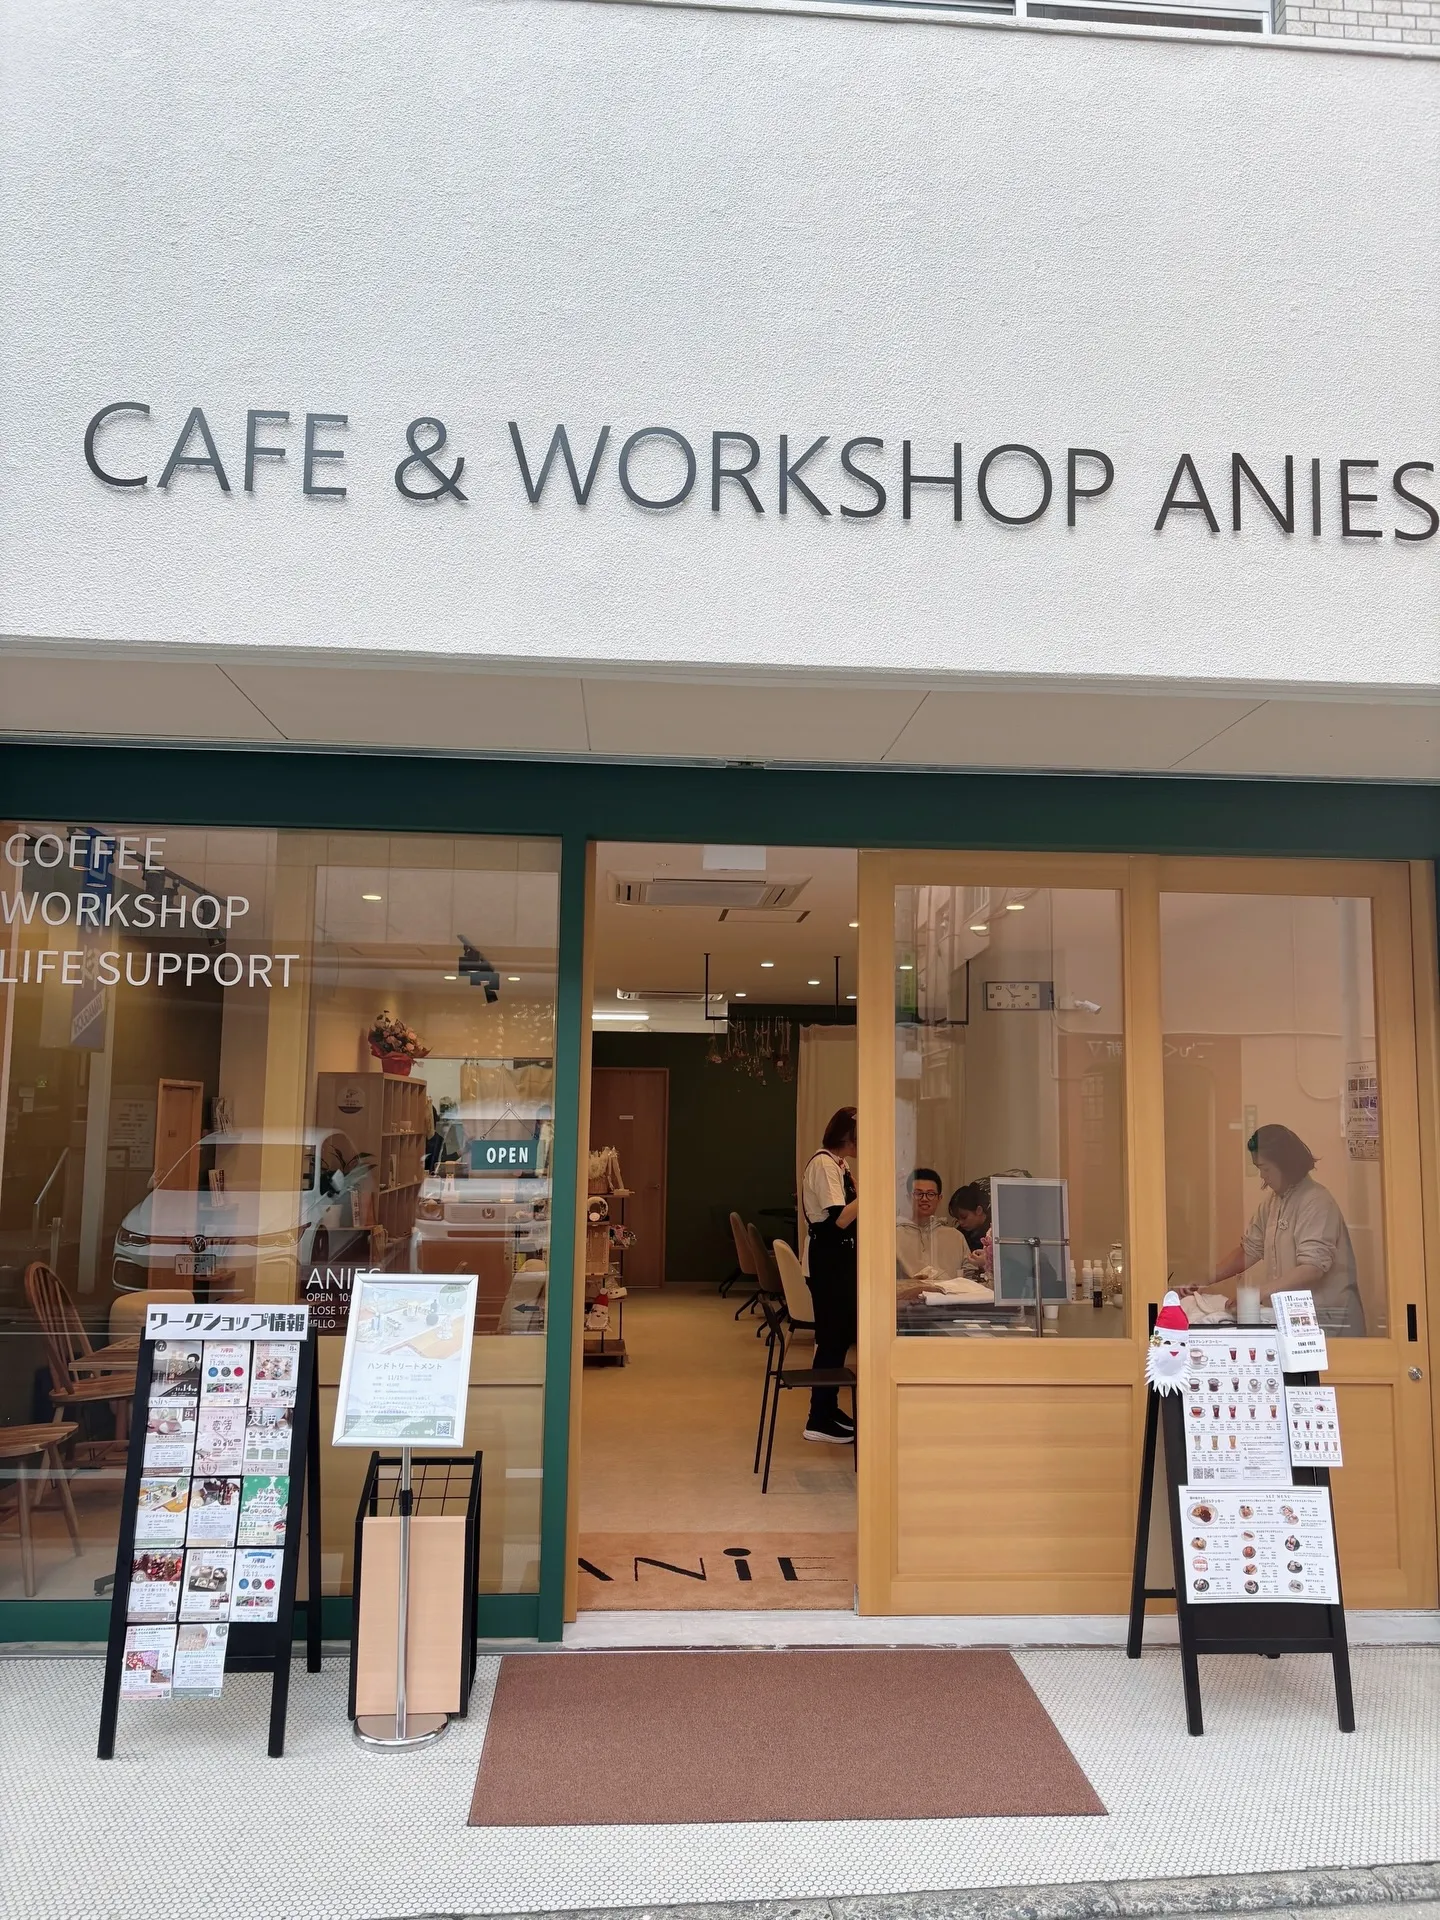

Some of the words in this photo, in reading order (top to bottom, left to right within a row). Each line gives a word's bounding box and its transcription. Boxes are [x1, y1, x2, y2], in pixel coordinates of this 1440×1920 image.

[84, 402, 348, 496] CAFE
[394, 416, 468, 501] &
[508, 422, 1114, 527] WORKSHOP
[1154, 453, 1439, 542] ANIES
[5, 834, 166, 871] COFFEE
[1, 891, 250, 930] WORKSHOP
[0, 950, 84, 985] LIFE
[97, 951, 300, 988] SUPPORT
[486, 1146, 529, 1164] OPEN
[306, 1267, 381, 1290] ANI
[306, 1293, 334, 1302] OPEN
[149, 1312, 305, 1332] ワークショップ情報
[367, 1362, 443, 1371] ハンドトリートメント
[247, 1412, 277, 1428] 友活
